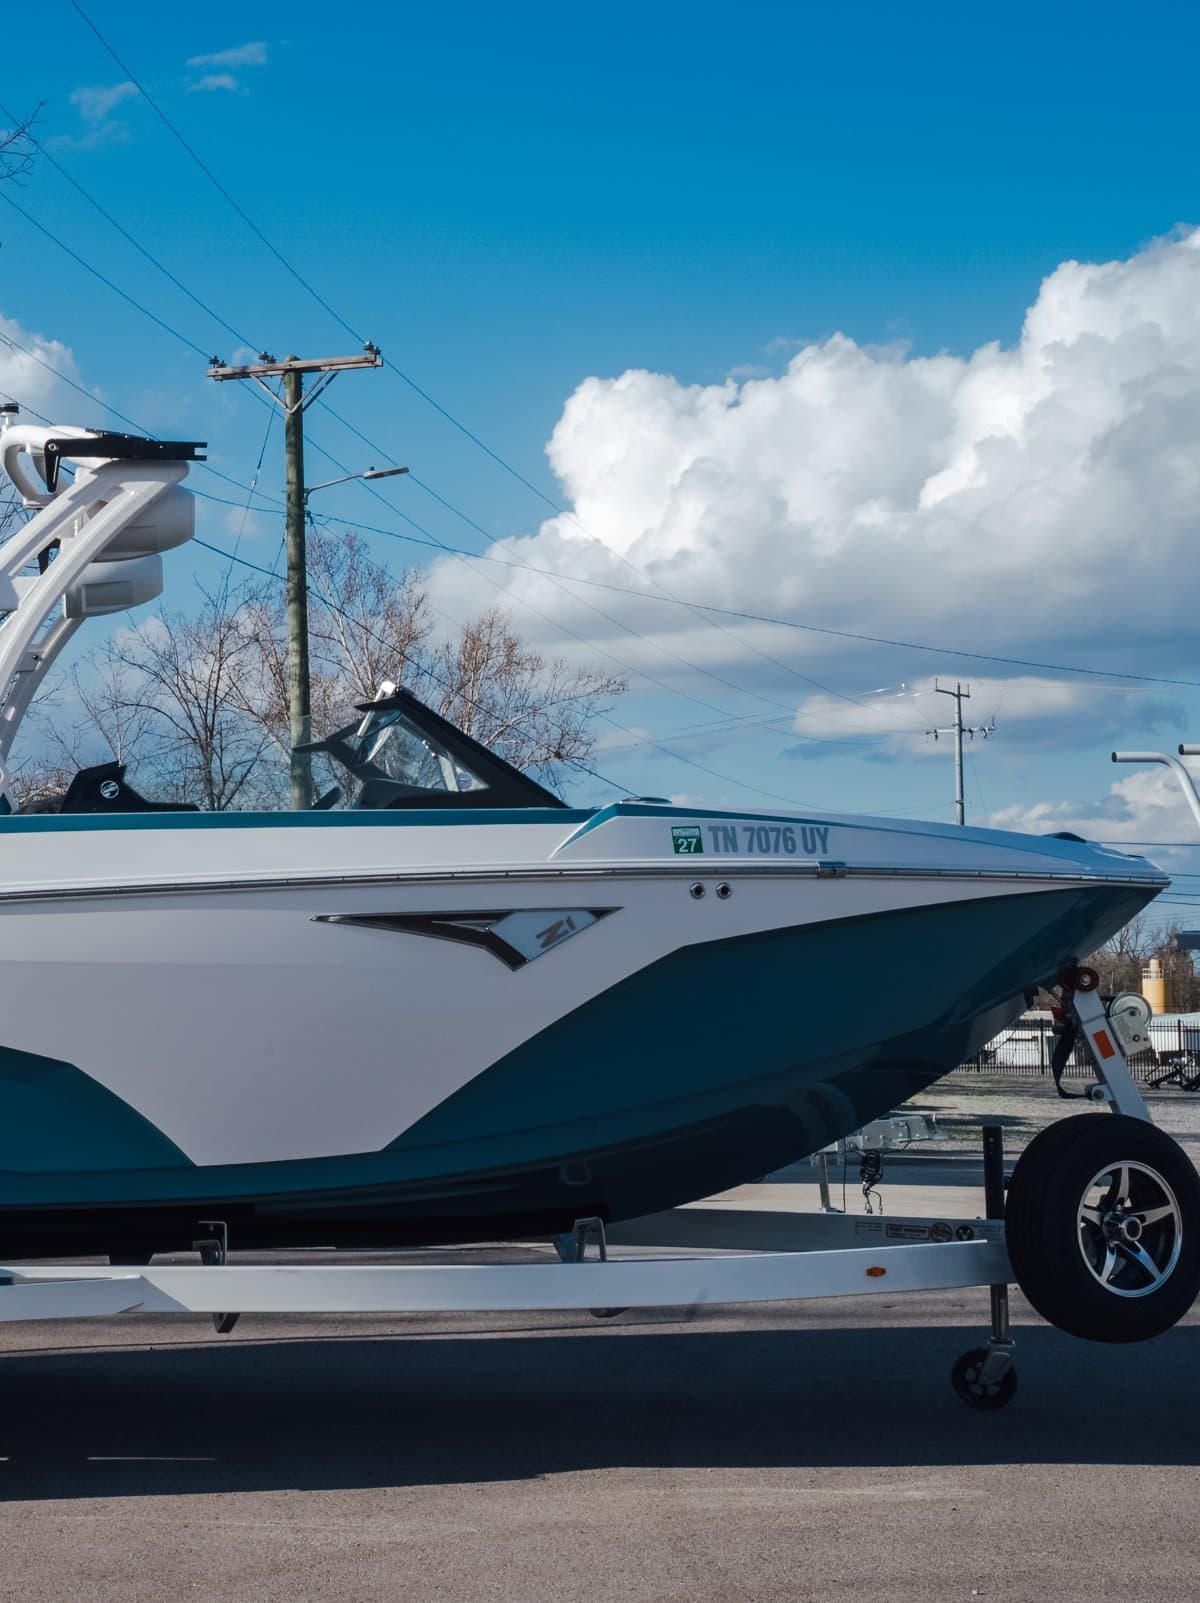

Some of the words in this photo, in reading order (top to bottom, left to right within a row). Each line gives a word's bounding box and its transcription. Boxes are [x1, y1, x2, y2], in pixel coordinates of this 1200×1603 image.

[678, 838, 697, 853] 27
[707, 826, 738, 853] TN
[743, 826, 796, 854] 7076
[801, 827, 829, 855] UY
